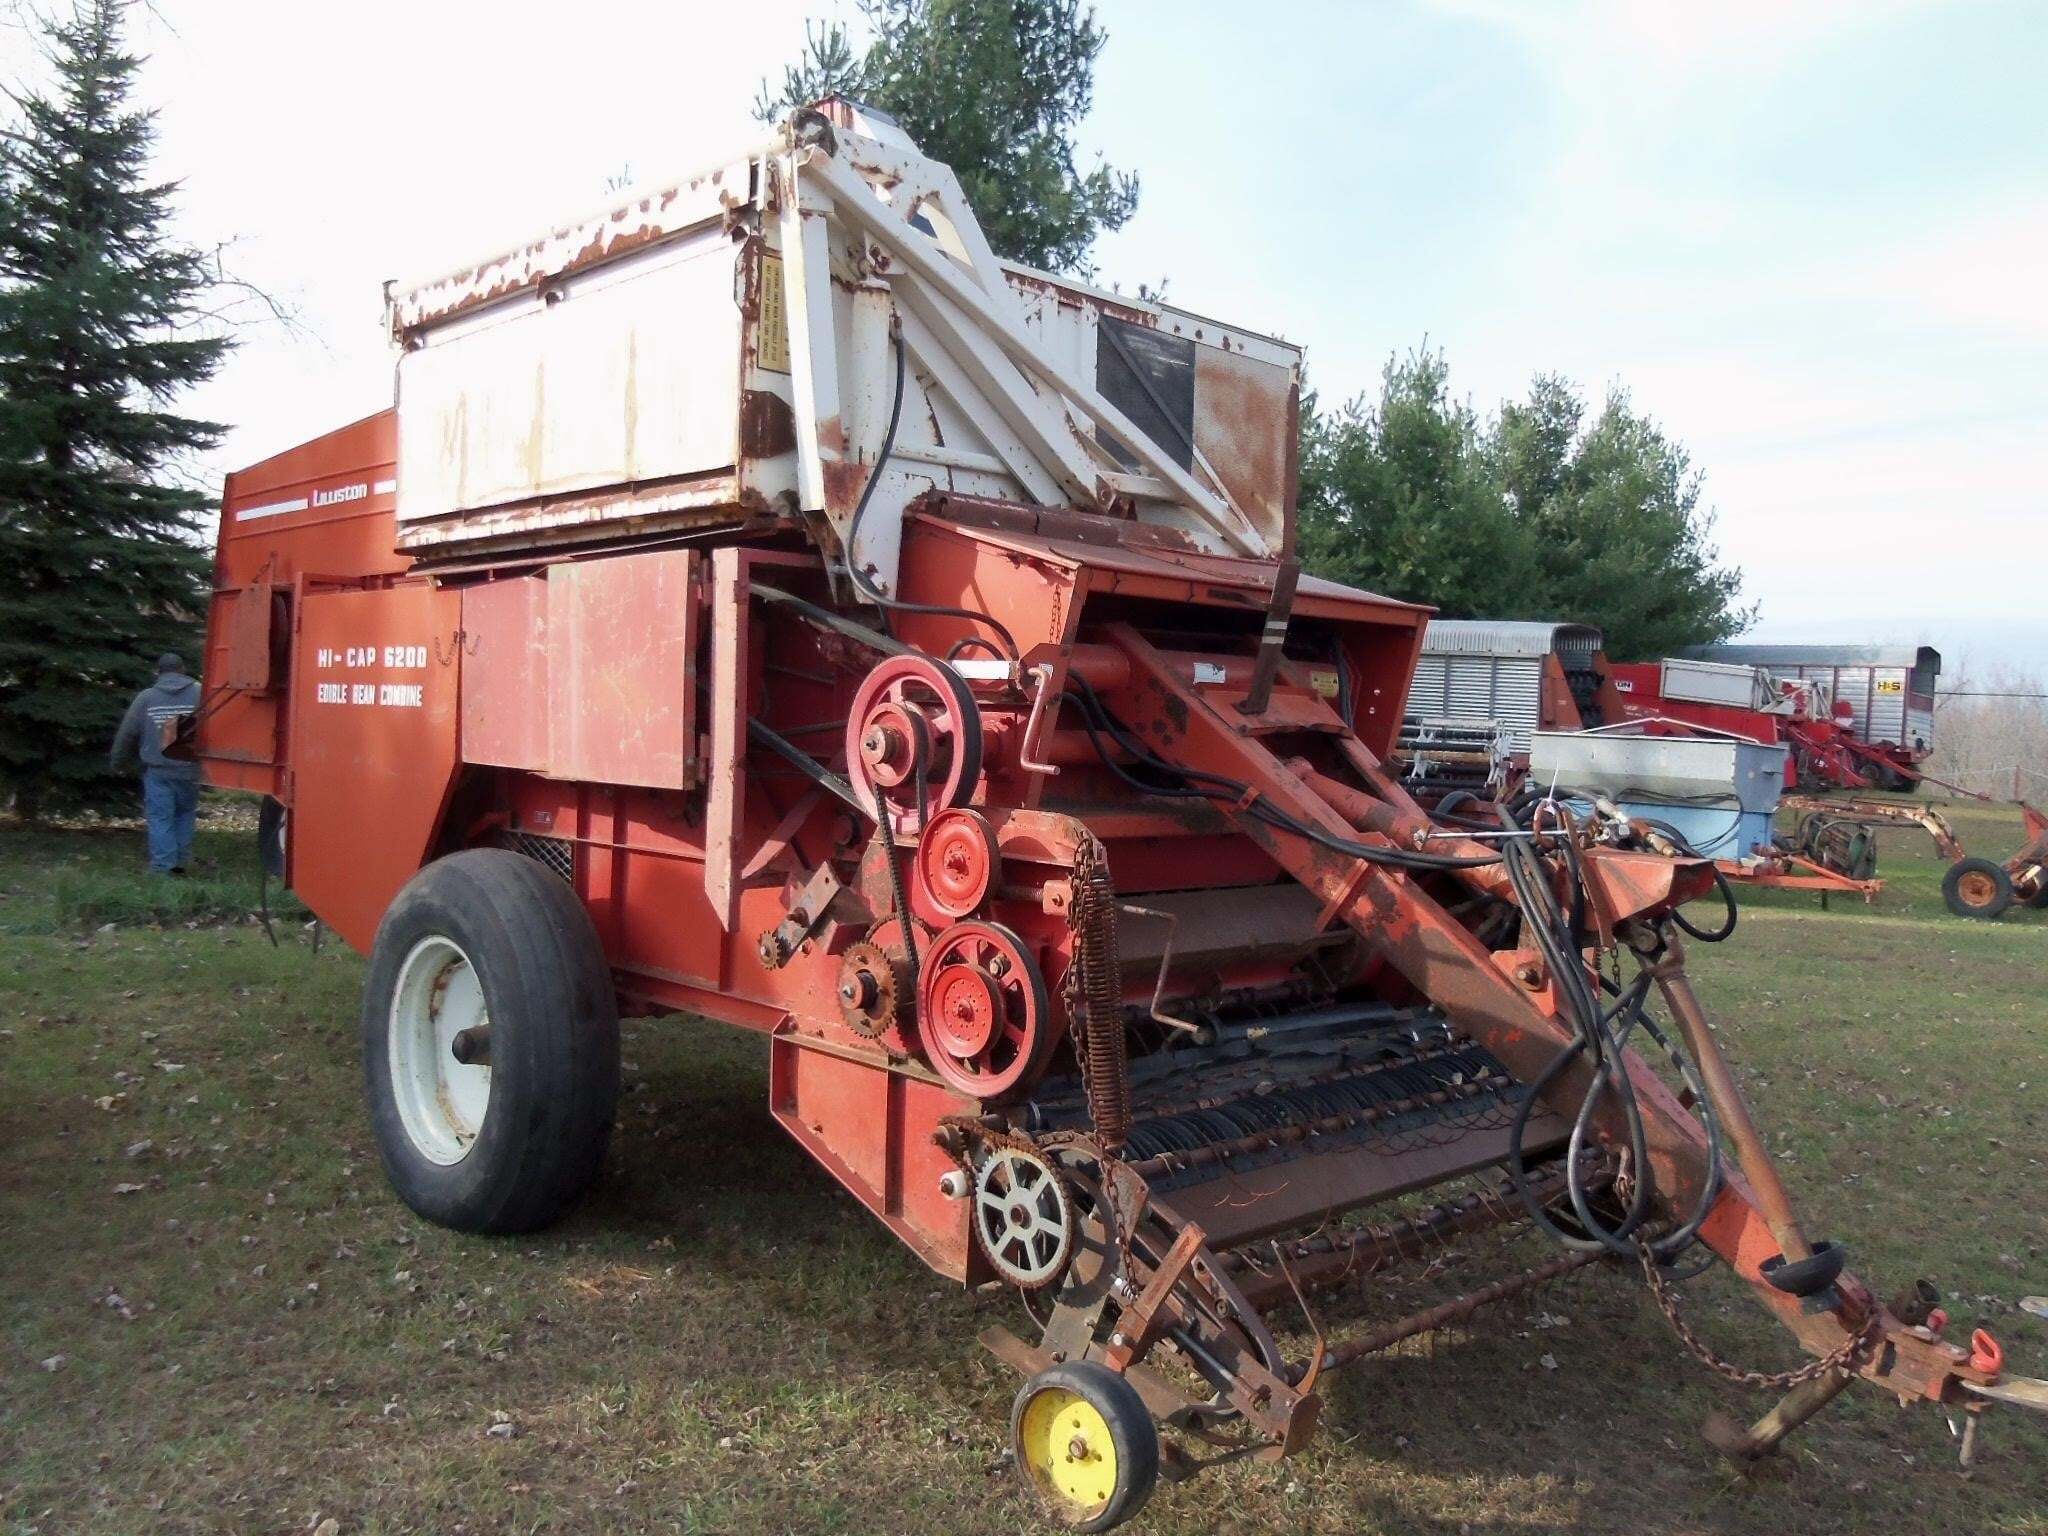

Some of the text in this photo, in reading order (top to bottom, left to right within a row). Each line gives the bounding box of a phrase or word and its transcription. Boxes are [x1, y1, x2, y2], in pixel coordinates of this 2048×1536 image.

[384, 646, 427, 668] 6200
[317, 683, 423, 707] EDIBLE BEAN COMBINE
